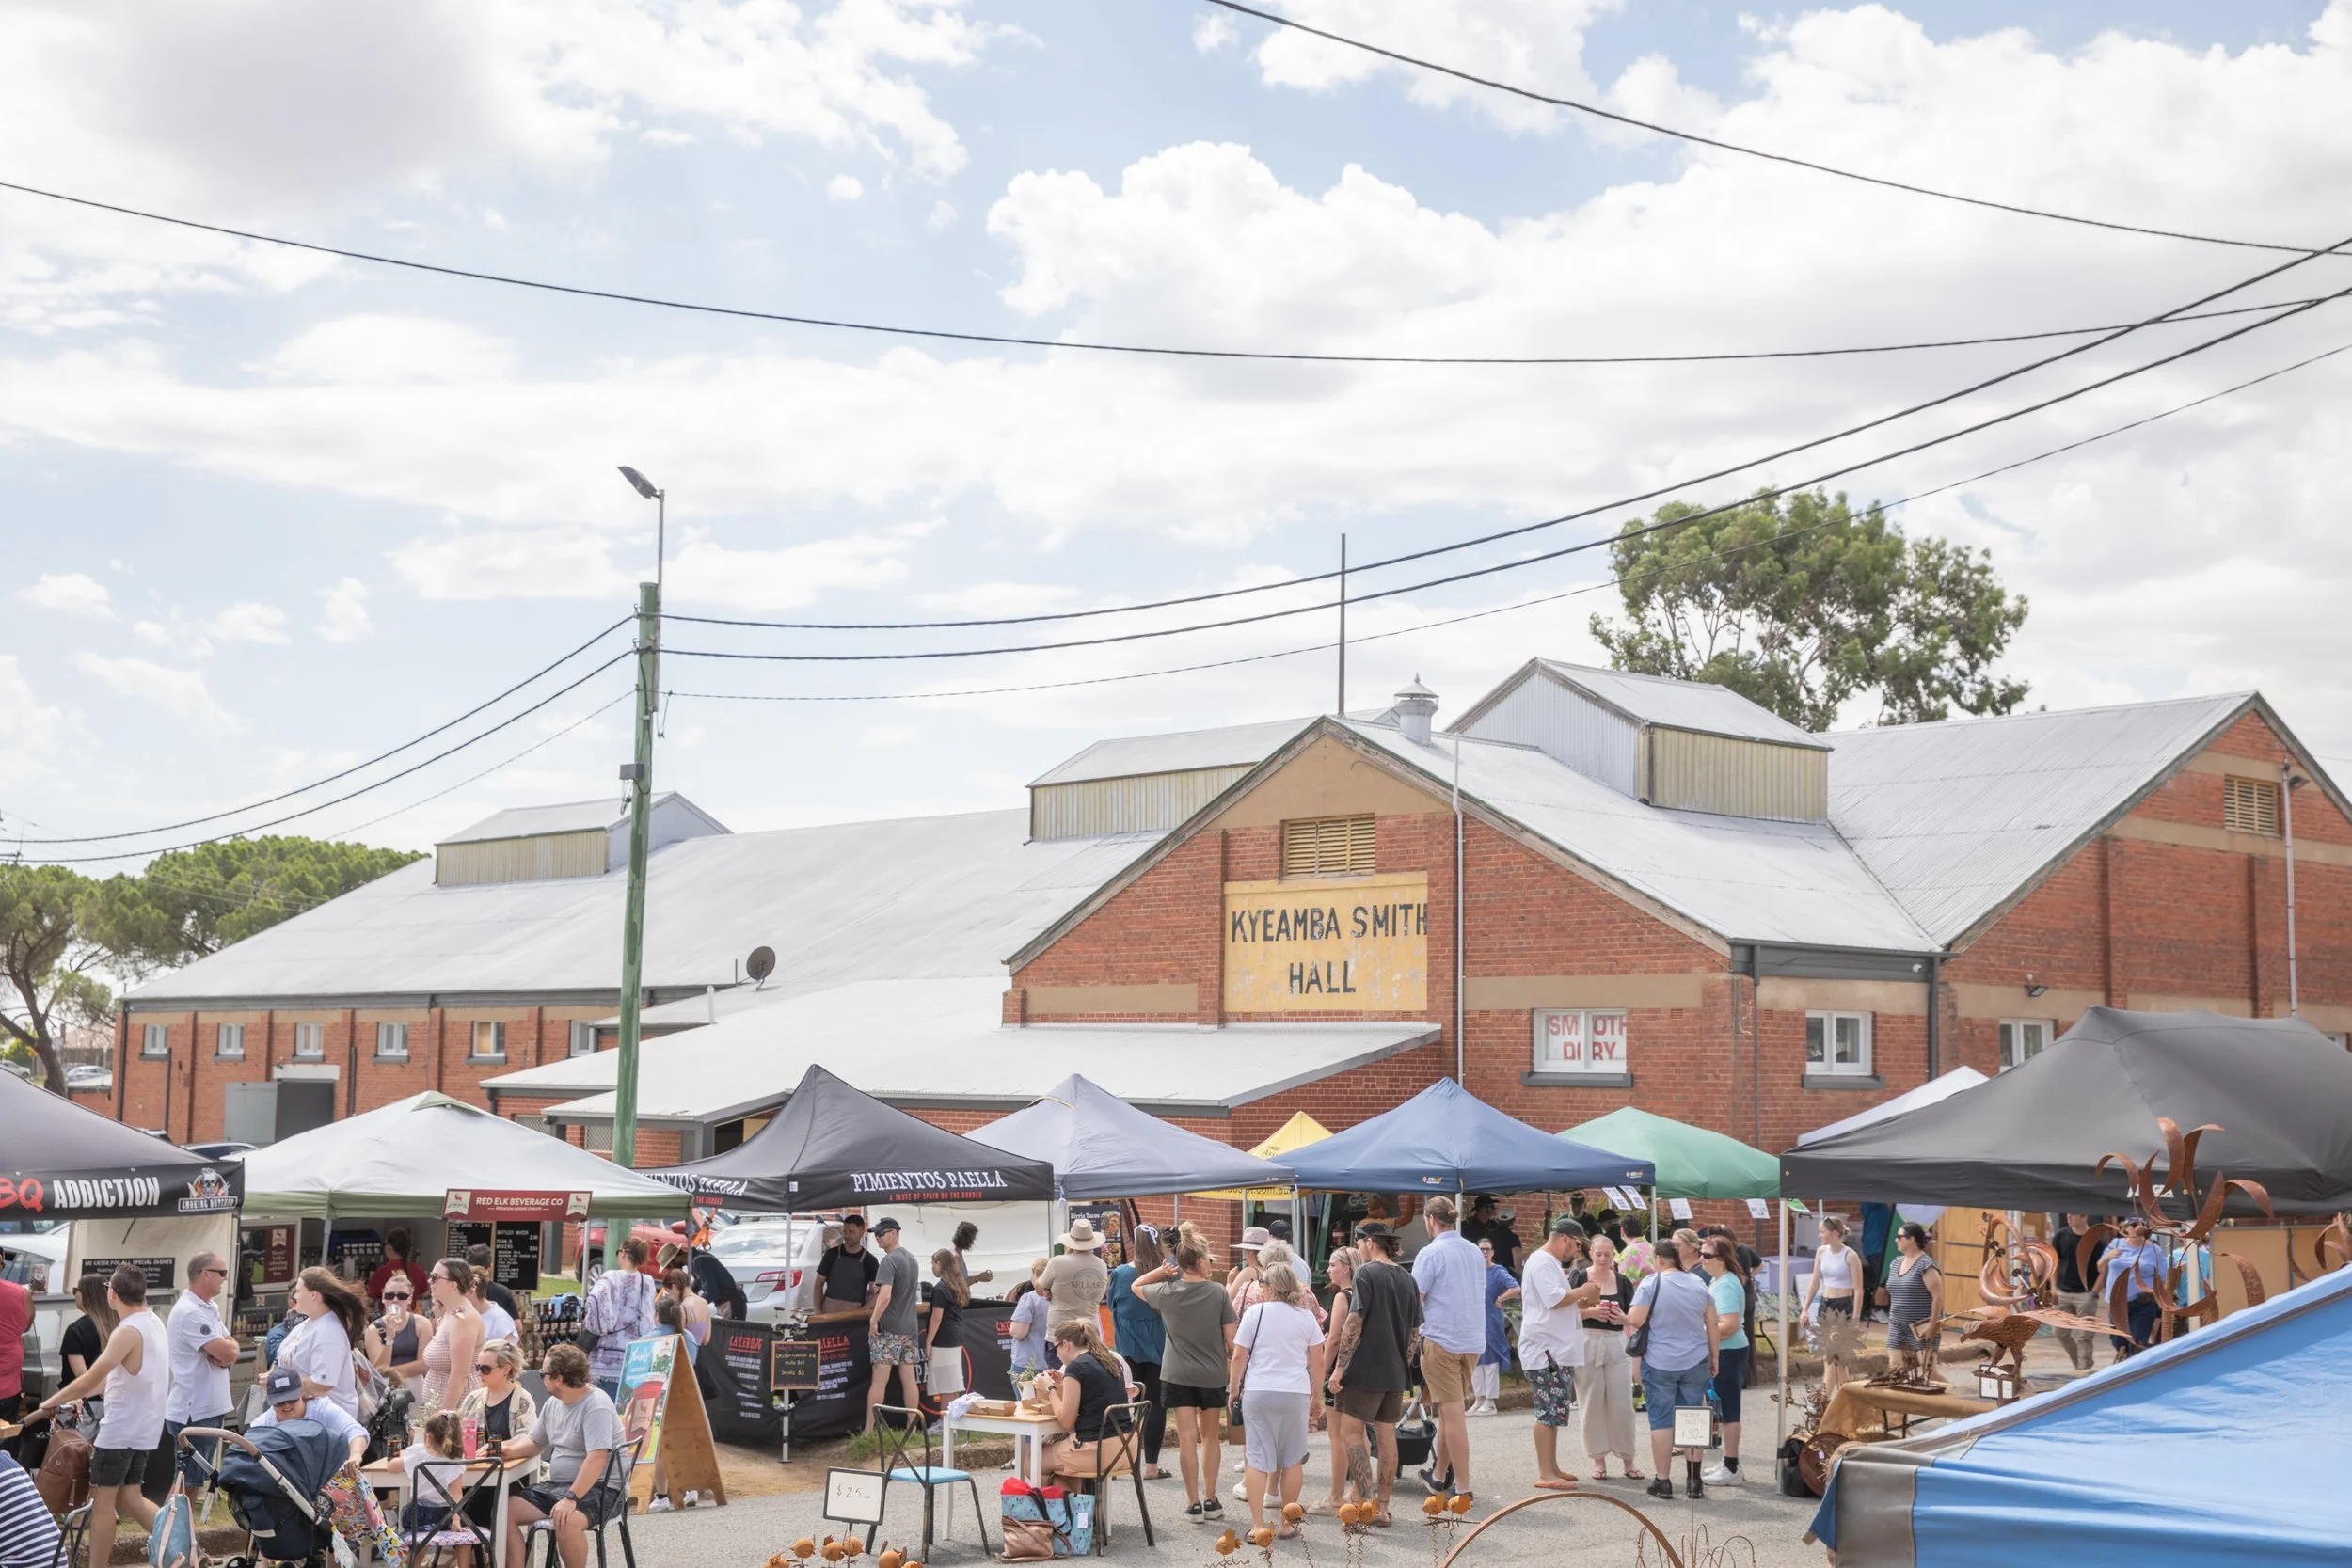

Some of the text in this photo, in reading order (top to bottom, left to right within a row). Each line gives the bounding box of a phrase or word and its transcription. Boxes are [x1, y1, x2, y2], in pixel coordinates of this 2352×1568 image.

[1232, 903, 1428, 942] KYEAMBA SMITH
[1289, 960, 1357, 994] HALL
[850, 1170, 1008, 1192] PIMIENTOS PAELLA
[53, 1177, 161, 1209] ADDICTION
[494, 1197, 509, 1206] ELK
[510, 1197, 550, 1206] BEVERAGE
[950, 1191, 960, 1199] THE
[182, 1199, 208, 1210] SMOKING
[729, 1336, 763, 1350] CATERING
